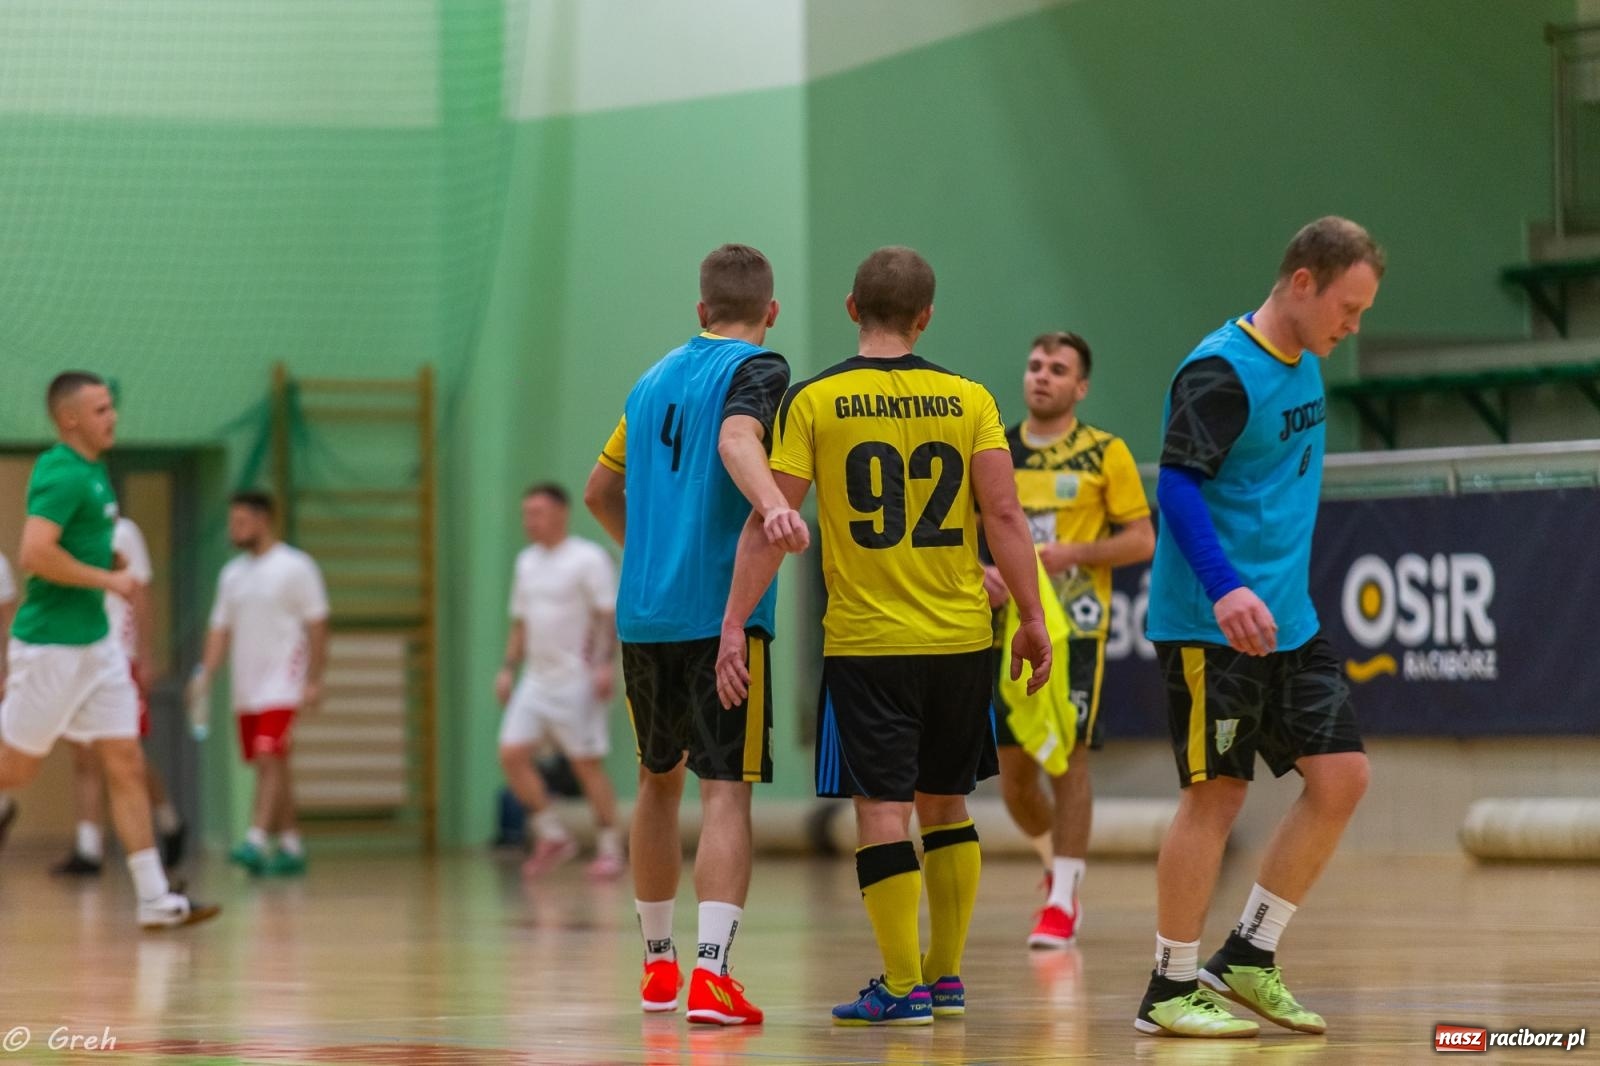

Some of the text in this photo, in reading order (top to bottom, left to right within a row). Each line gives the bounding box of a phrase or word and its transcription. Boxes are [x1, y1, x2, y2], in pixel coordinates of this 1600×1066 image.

[660, 403, 685, 472] 4
[835, 394, 964, 419] GALAKTIKOS
[845, 441, 965, 550] 92
